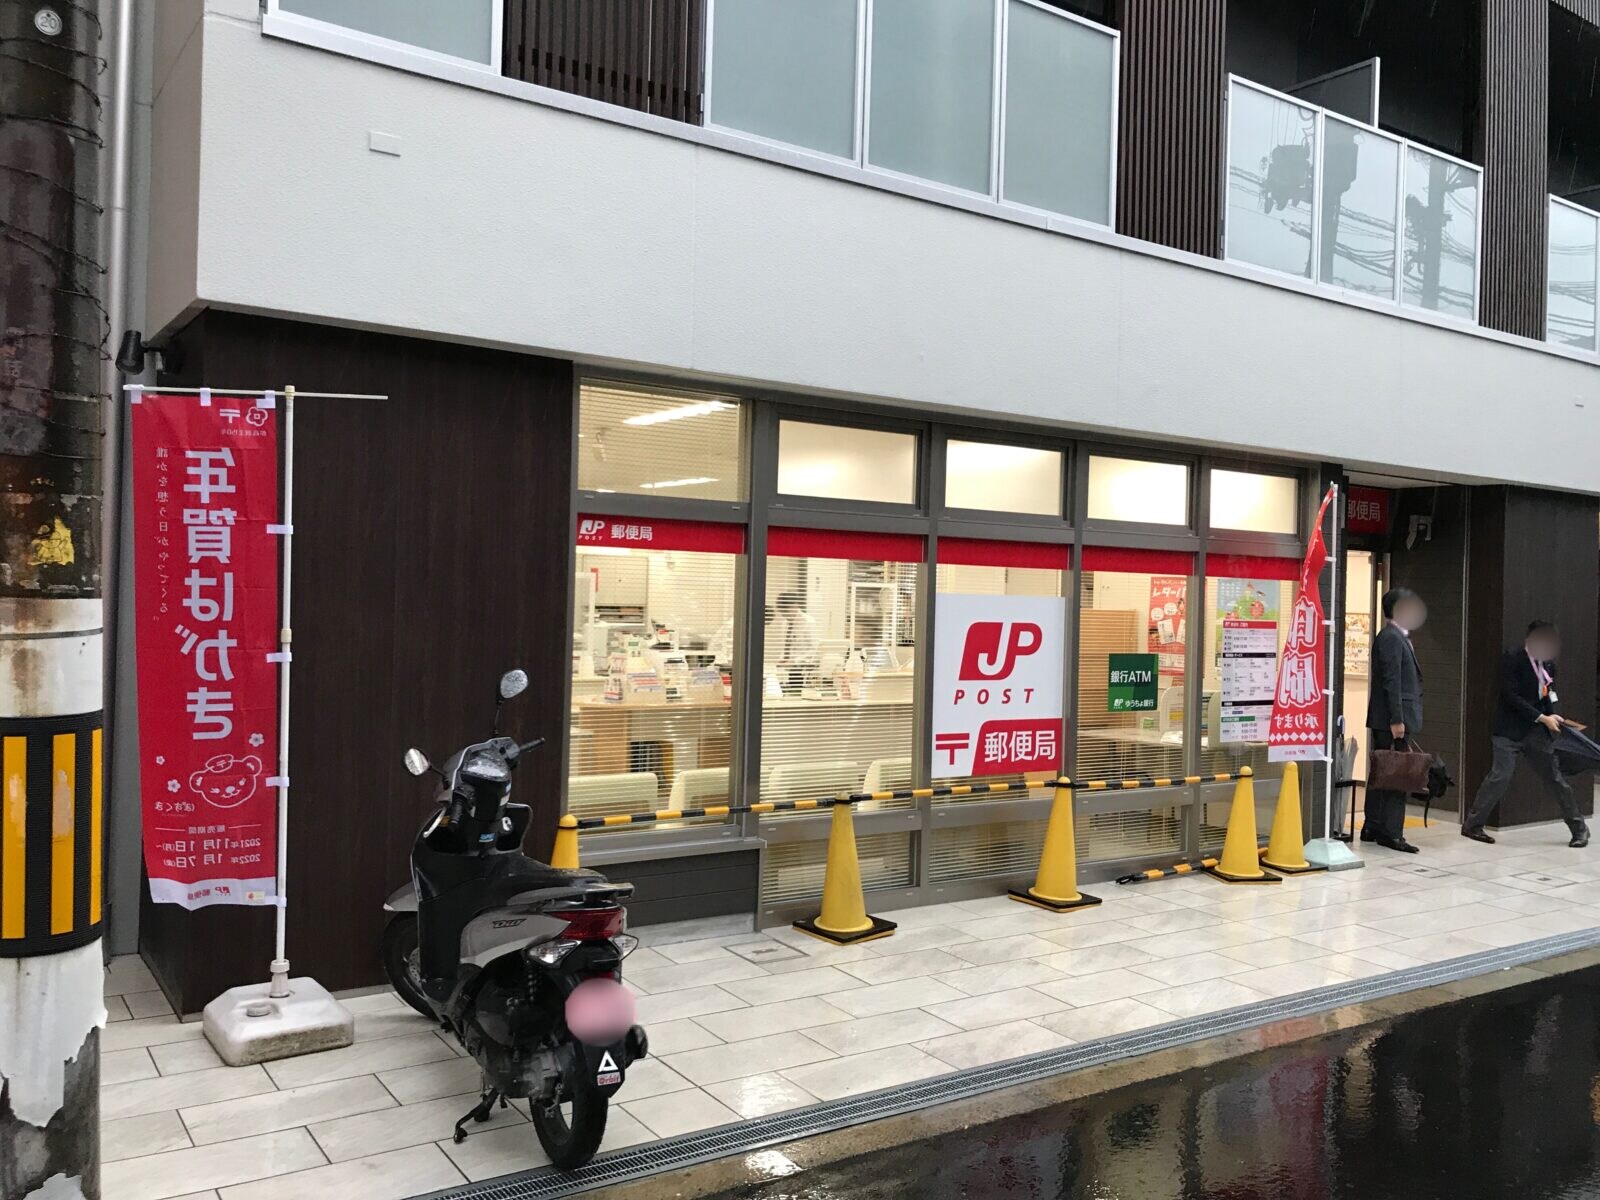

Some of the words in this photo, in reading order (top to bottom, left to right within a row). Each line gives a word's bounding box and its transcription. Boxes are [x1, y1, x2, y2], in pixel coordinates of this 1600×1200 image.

[40, 16, 58, 29] 20
[610, 524, 653, 541] 郵便局
[958, 621, 1043, 681] JP
[1110, 670, 1152, 683] 銀行ATM
[953, 688, 1035, 706] POST
[1125, 698, 1154, 708] ゆうちょ銀行
[984, 730, 1057, 763] 郵便局
